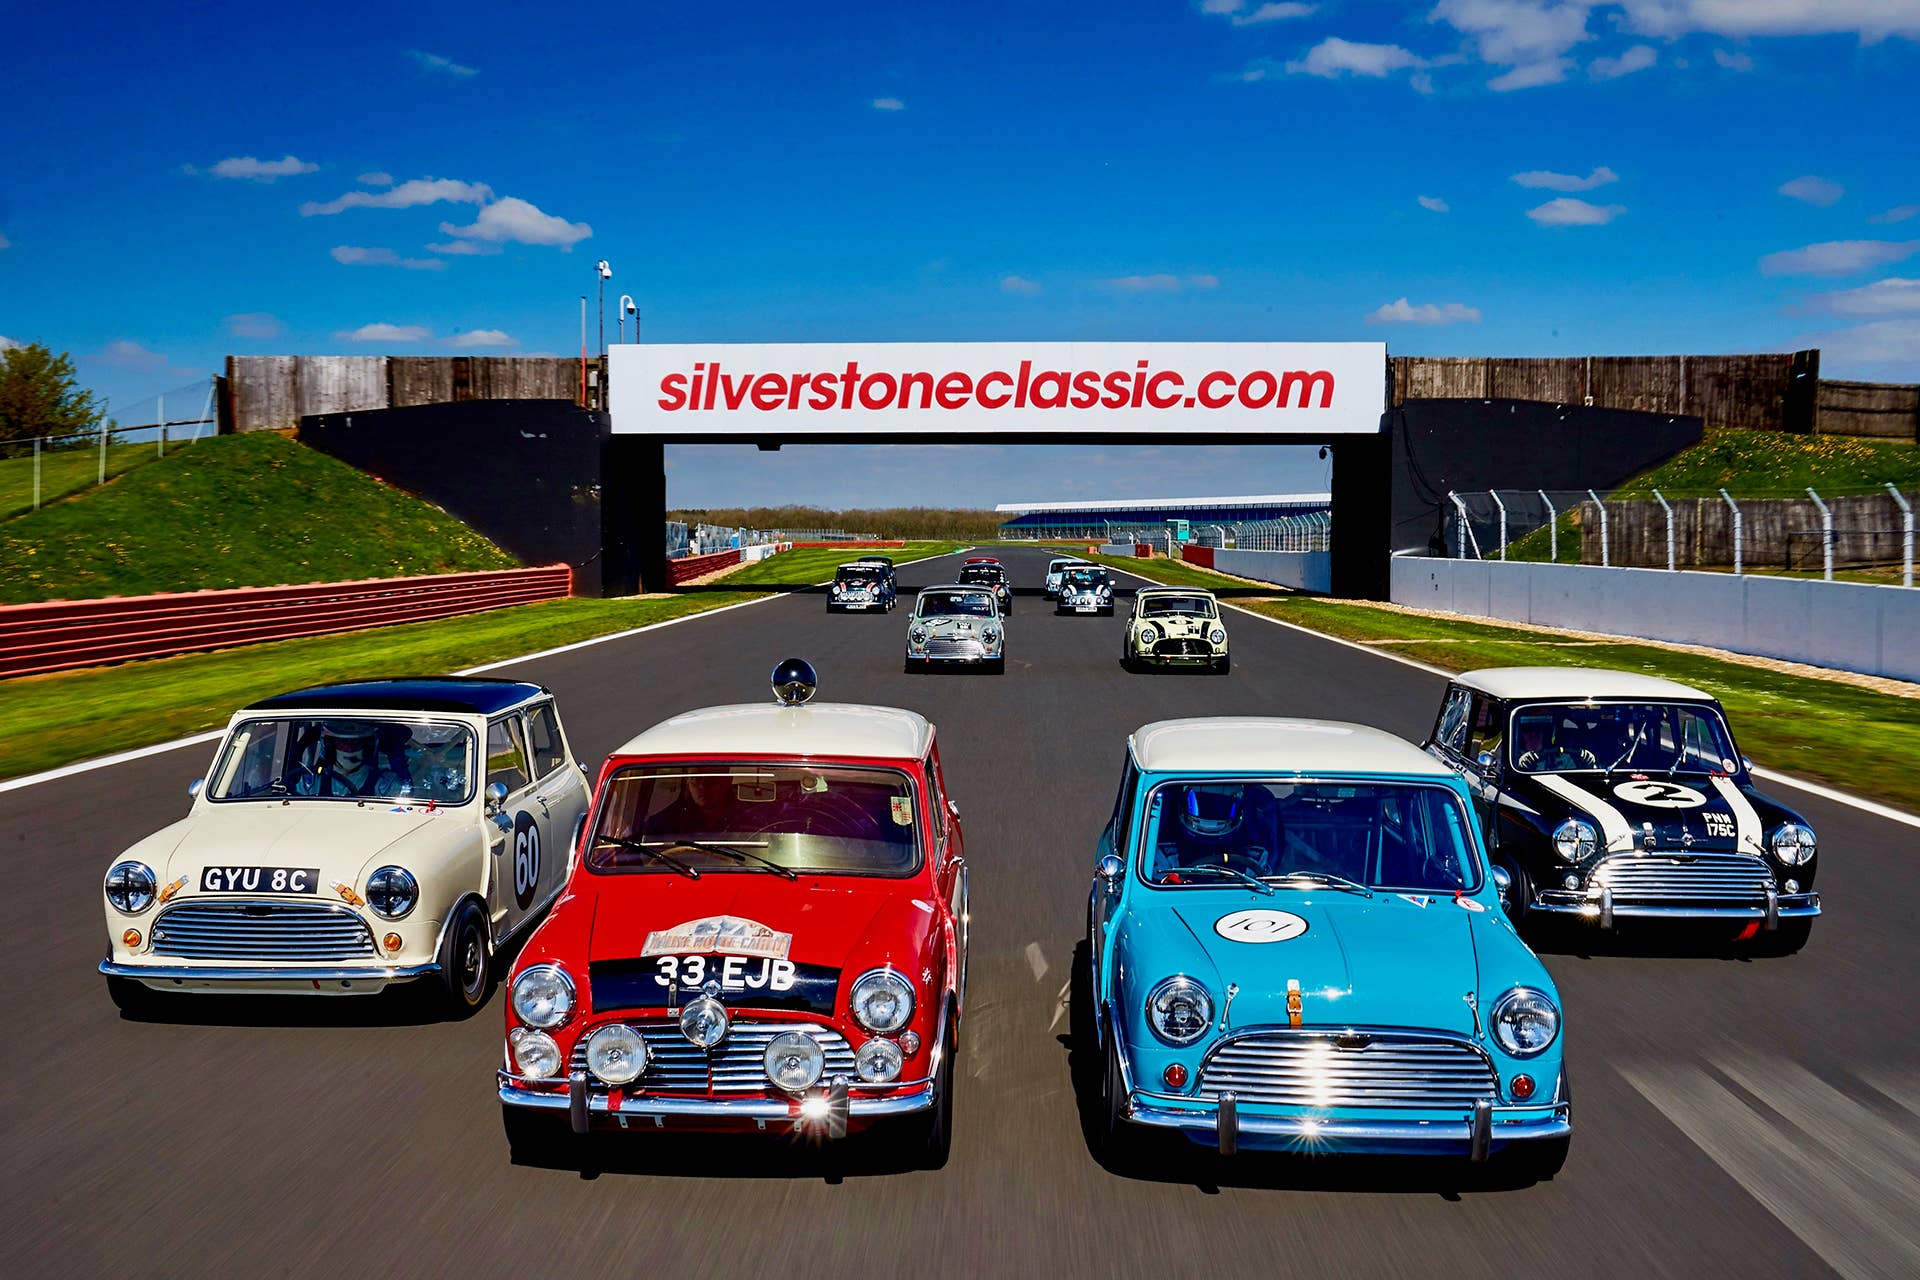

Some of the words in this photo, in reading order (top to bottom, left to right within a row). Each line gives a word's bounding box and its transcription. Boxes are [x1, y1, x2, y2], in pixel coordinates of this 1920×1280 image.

[658, 359, 1335, 411] silverstoneclassic.com
[1632, 783, 1695, 802] 2
[1706, 823, 1736, 837] 175C
[516, 825, 539, 896] 60
[205, 868, 261, 890] GYU
[271, 869, 307, 891] 8C
[654, 956, 706, 986] 33
[722, 956, 796, 991] EJB
